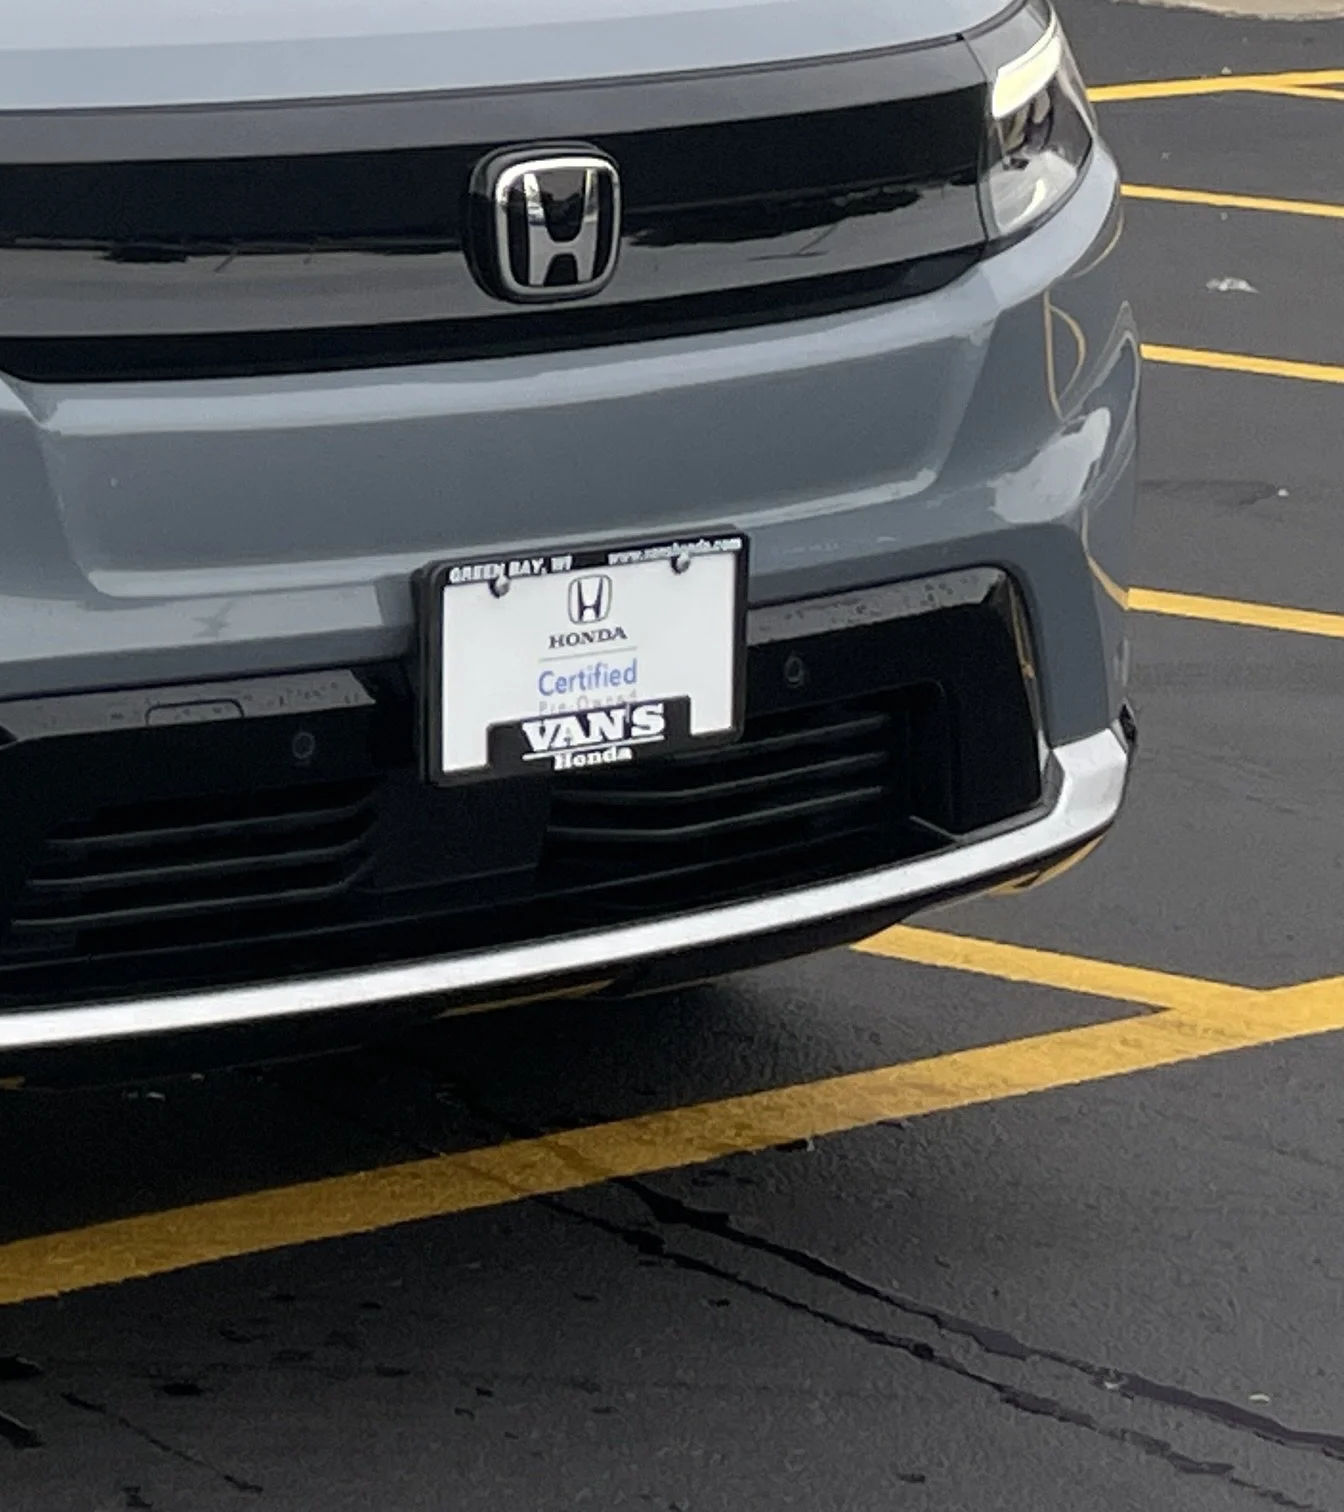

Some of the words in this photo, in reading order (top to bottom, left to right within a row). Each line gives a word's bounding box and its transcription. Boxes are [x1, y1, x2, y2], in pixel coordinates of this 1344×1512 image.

[449, 562, 506, 584] GREEN
[508, 557, 547, 577] BAY,
[548, 626, 628, 649] HONDA
[538, 658, 638, 696] Certified
[553, 746, 633, 772] Honda
